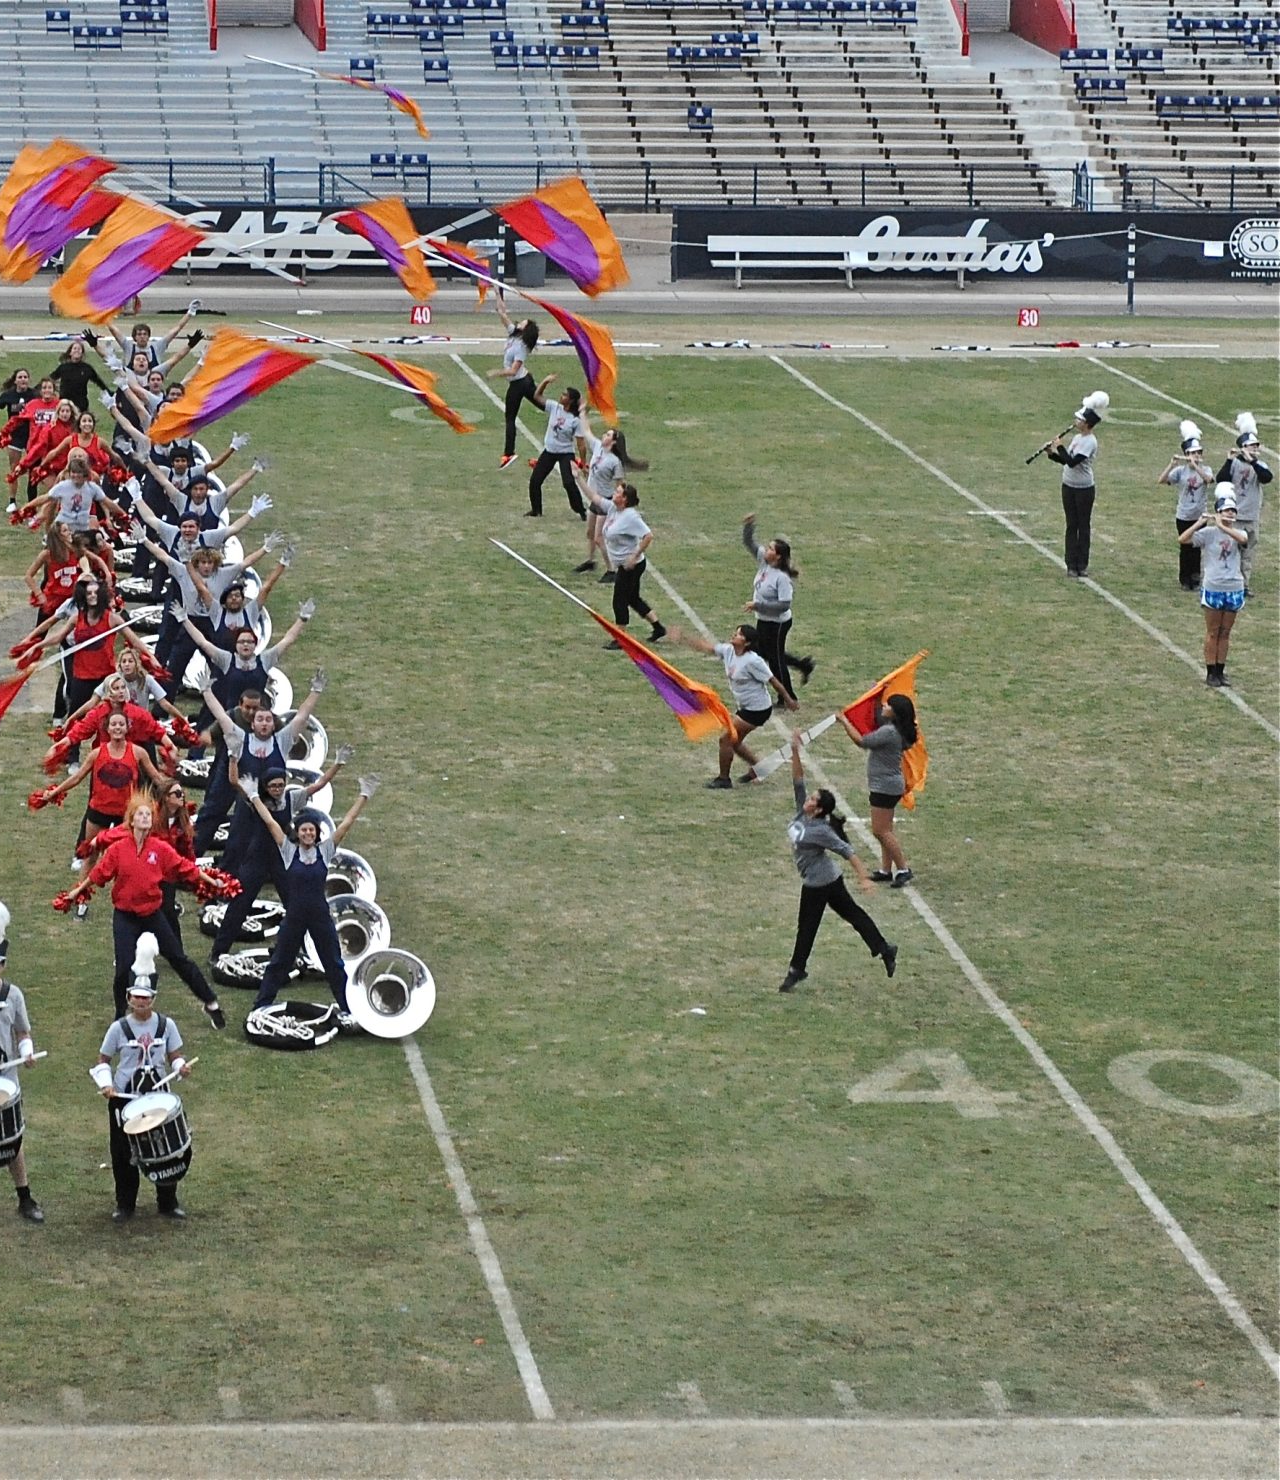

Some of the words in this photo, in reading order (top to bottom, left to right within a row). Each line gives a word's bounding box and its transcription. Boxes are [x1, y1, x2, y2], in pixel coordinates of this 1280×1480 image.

[413, 307, 431, 323] 40
[1020, 310, 1039, 327] 30
[158, 1162, 187, 1179] YAMAHA
